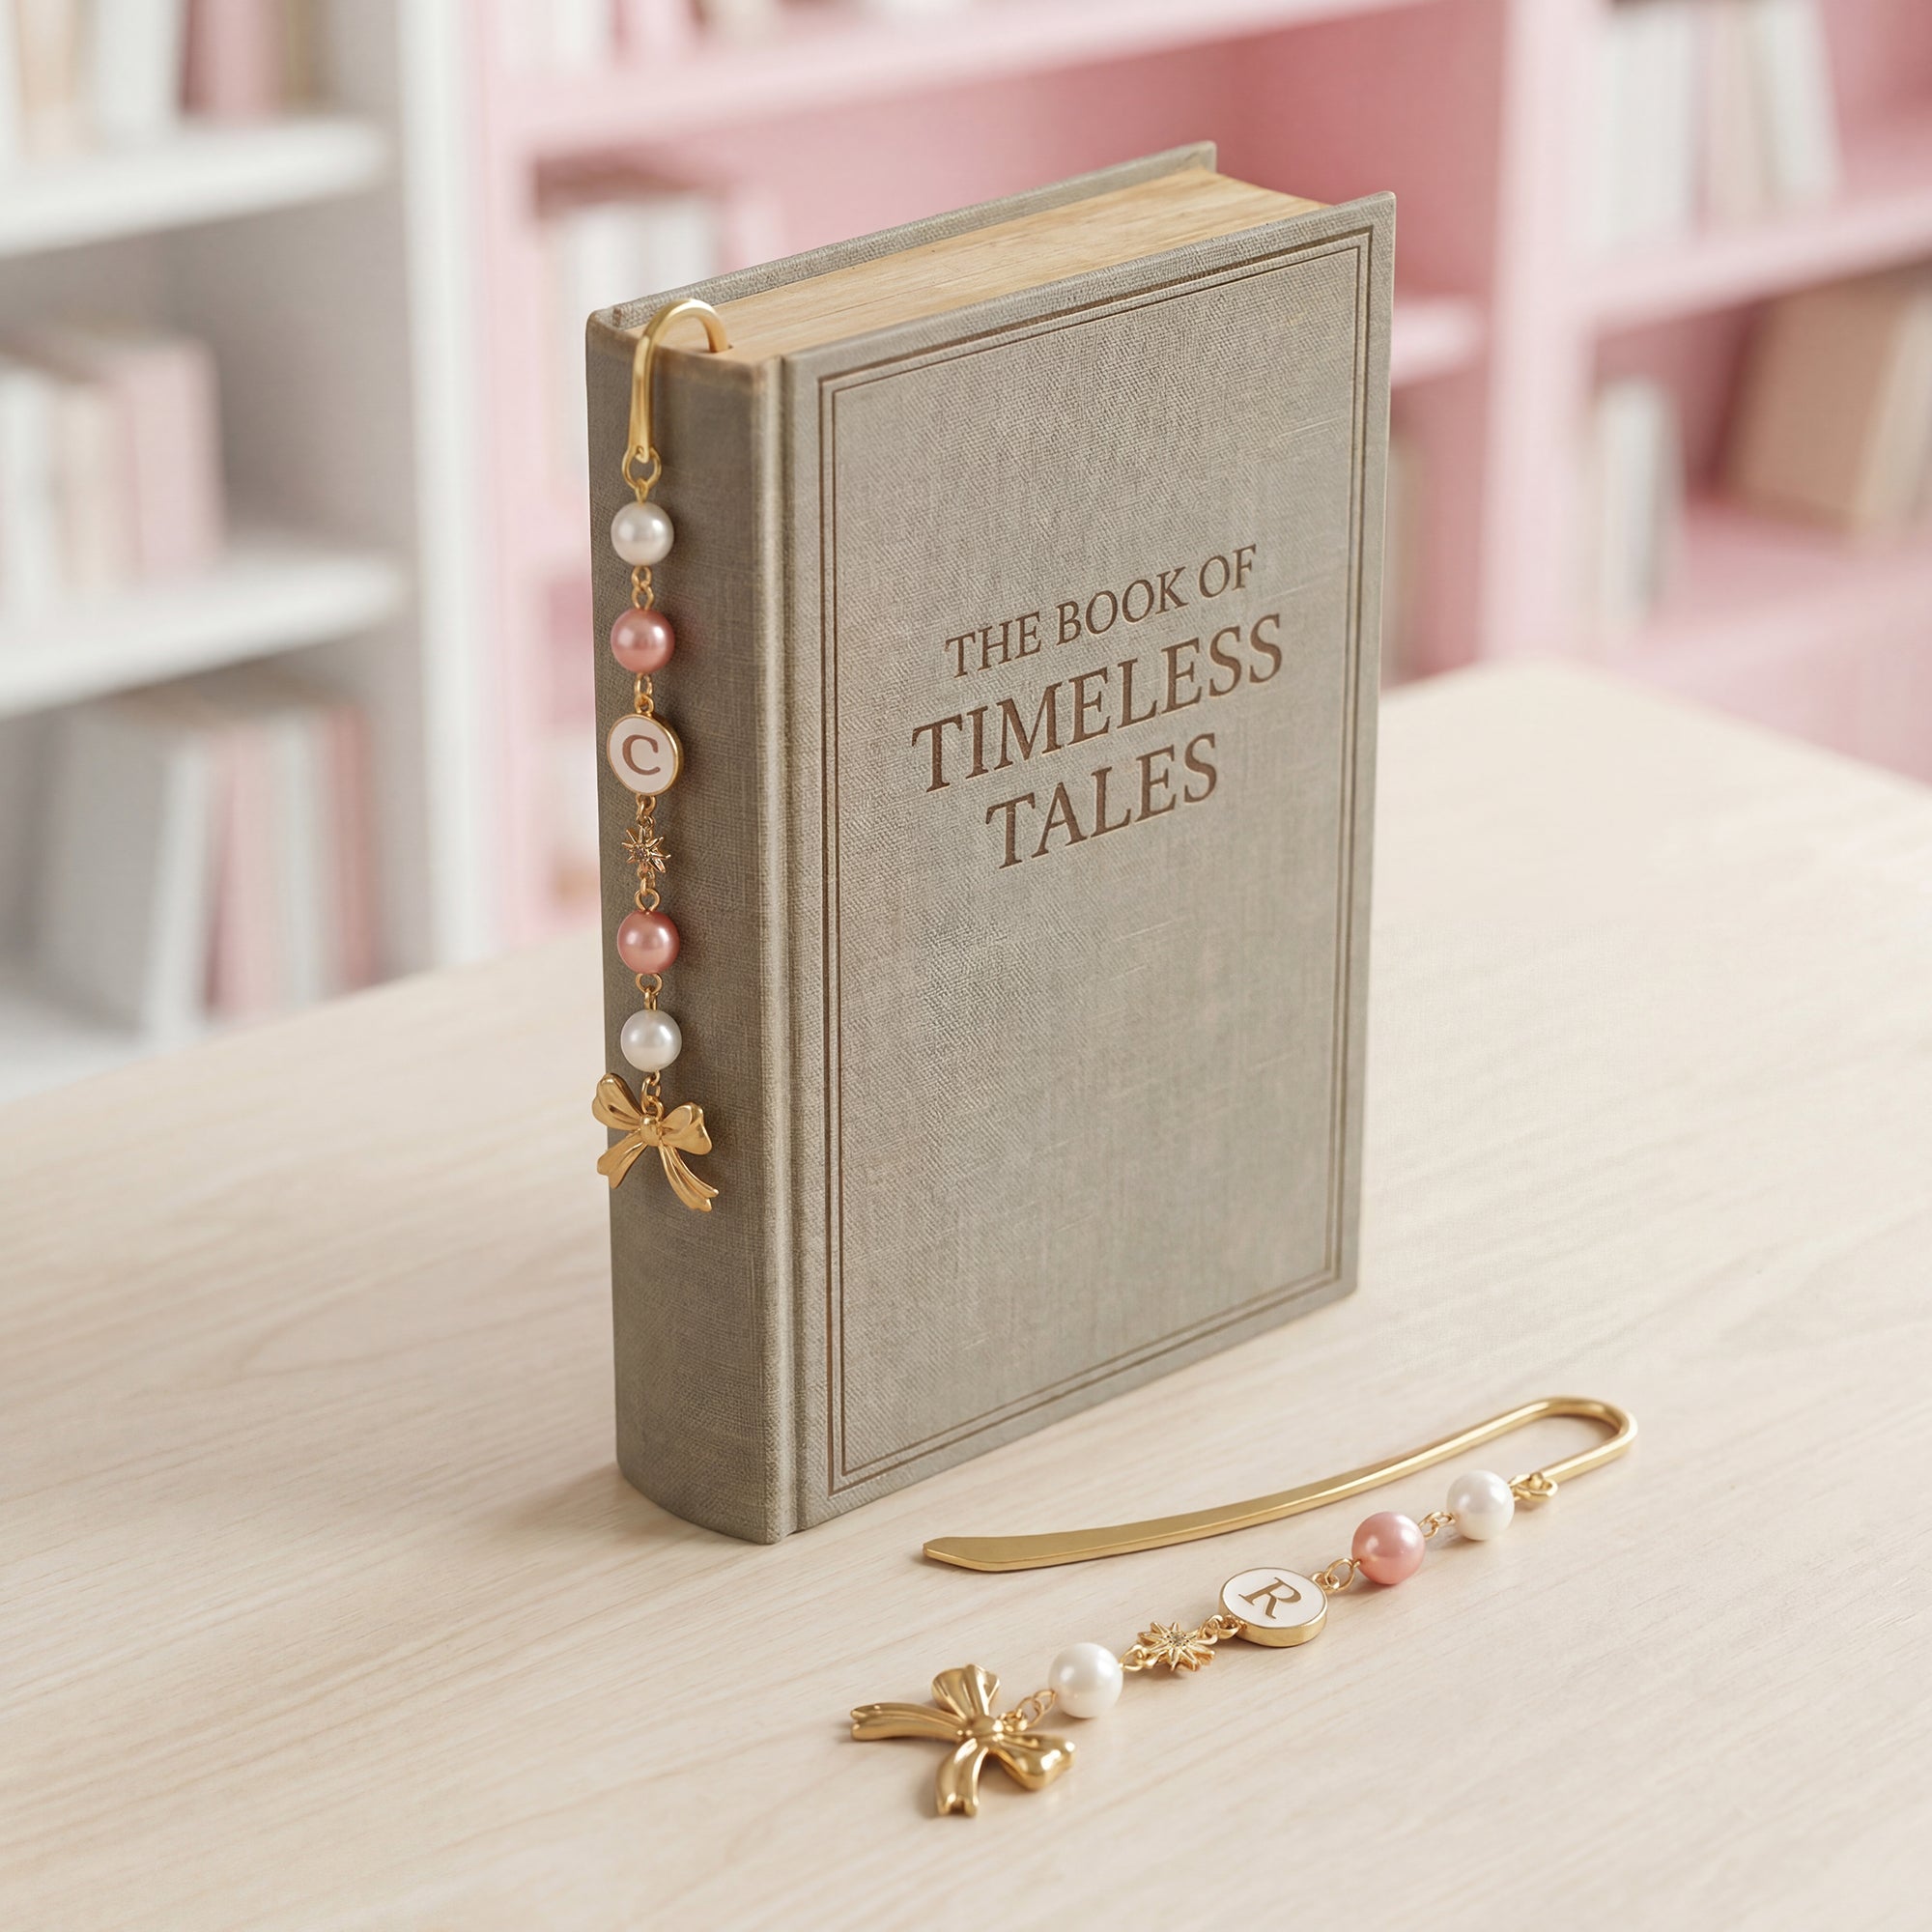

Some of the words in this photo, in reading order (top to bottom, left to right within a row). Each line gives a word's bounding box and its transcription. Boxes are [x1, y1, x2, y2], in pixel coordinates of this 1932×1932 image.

[945, 611, 1041, 678] THE
[1056, 567, 1188, 645] BOOK
[1198, 544, 1256, 599] OF
[622, 734, 661, 776] C
[911, 613, 1283, 793] TIMELESS
[985, 732, 1218, 869] TALES
[1238, 1577, 1302, 1619] R
